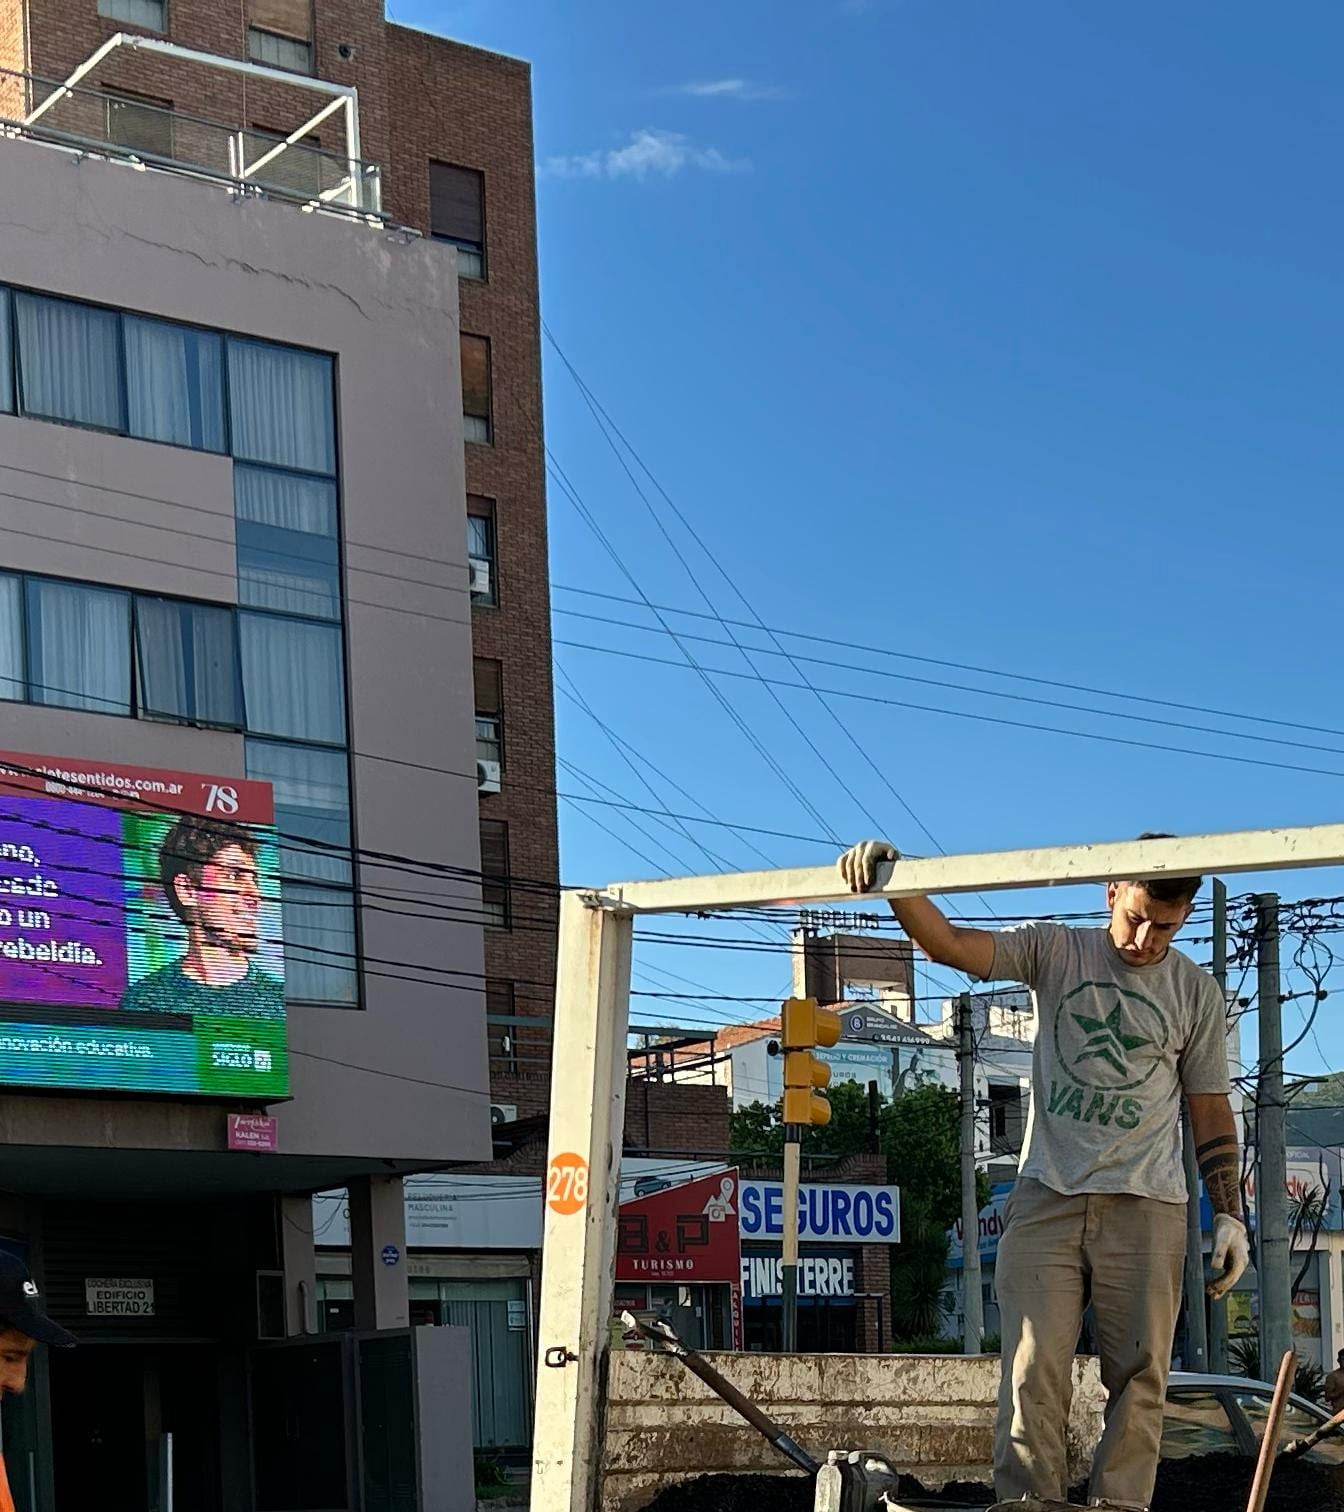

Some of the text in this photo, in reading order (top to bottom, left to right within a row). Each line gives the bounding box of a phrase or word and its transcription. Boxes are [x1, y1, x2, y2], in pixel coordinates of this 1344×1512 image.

[18, 909, 51, 929] un
[1047, 1081, 1143, 1129] VANS
[548, 1166, 588, 1202] 278
[741, 1186, 895, 1237] SEGUROS
[633, 1259, 694, 1271] TURISMO
[740, 1257, 855, 1298] FINISTERRE
[87, 1300, 140, 1313] LIBERTAD
[96, 1290, 146, 1300] EDIFICIO
